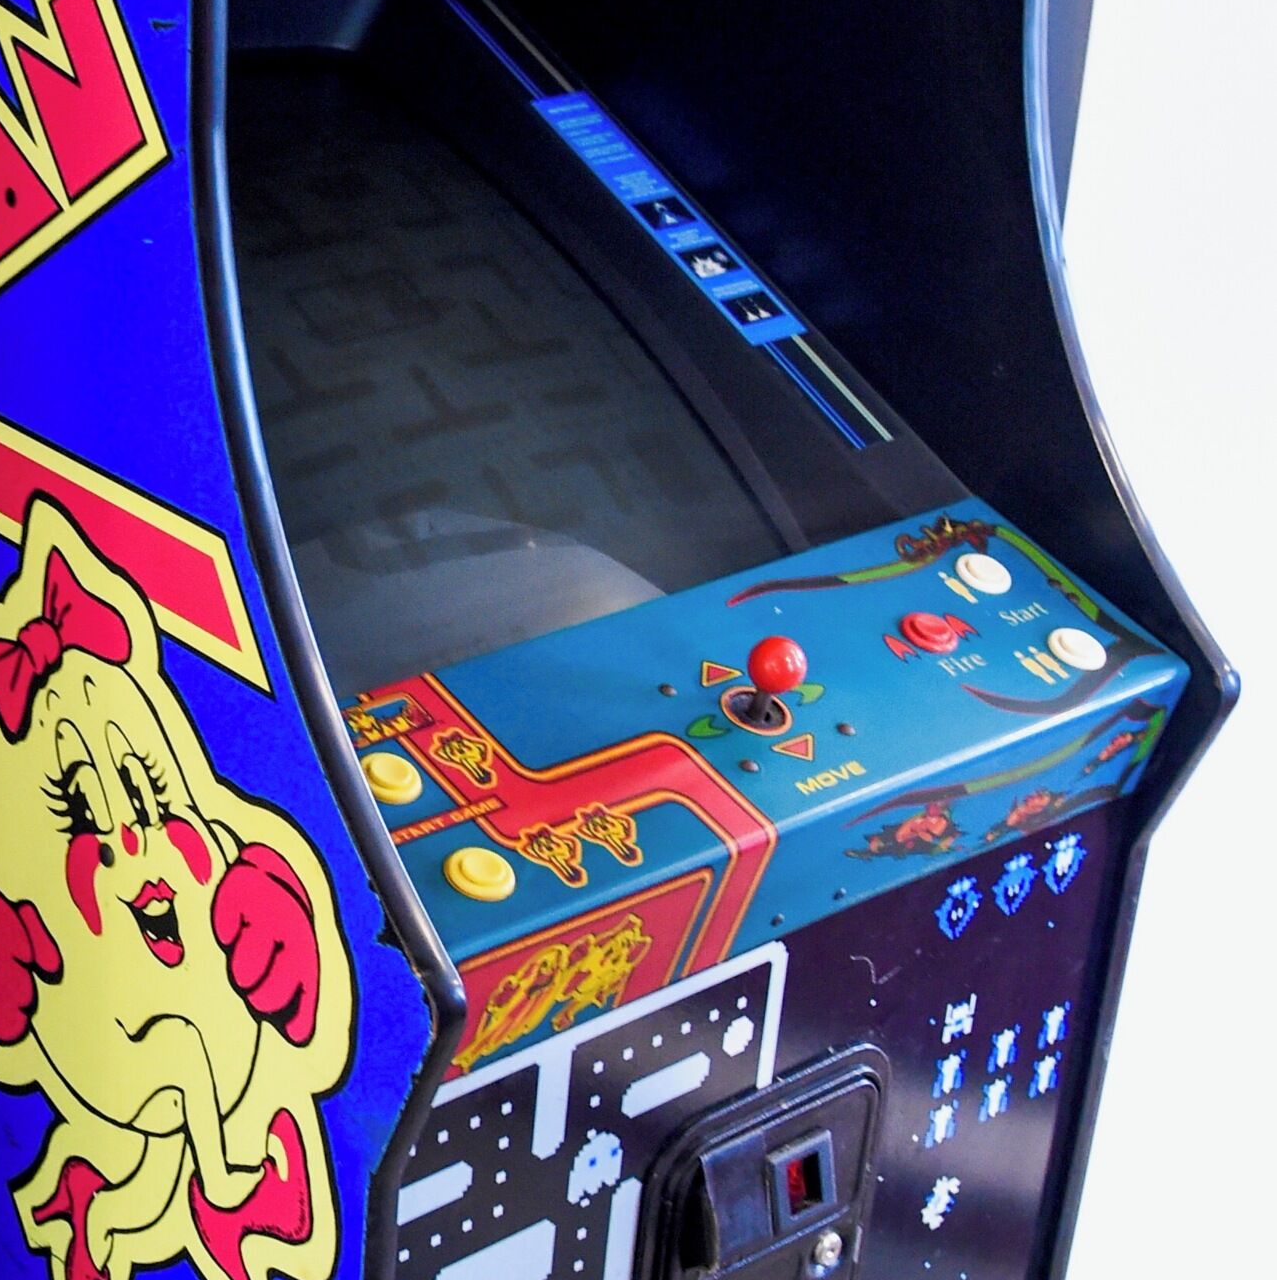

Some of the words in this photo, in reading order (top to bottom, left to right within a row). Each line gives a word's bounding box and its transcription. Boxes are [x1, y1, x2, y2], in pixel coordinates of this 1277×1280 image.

[998, 601, 1050, 627] Start
[937, 652, 988, 678] Fire
[794, 760, 867, 796] MOVE
[450, 796, 504, 823] GAME
